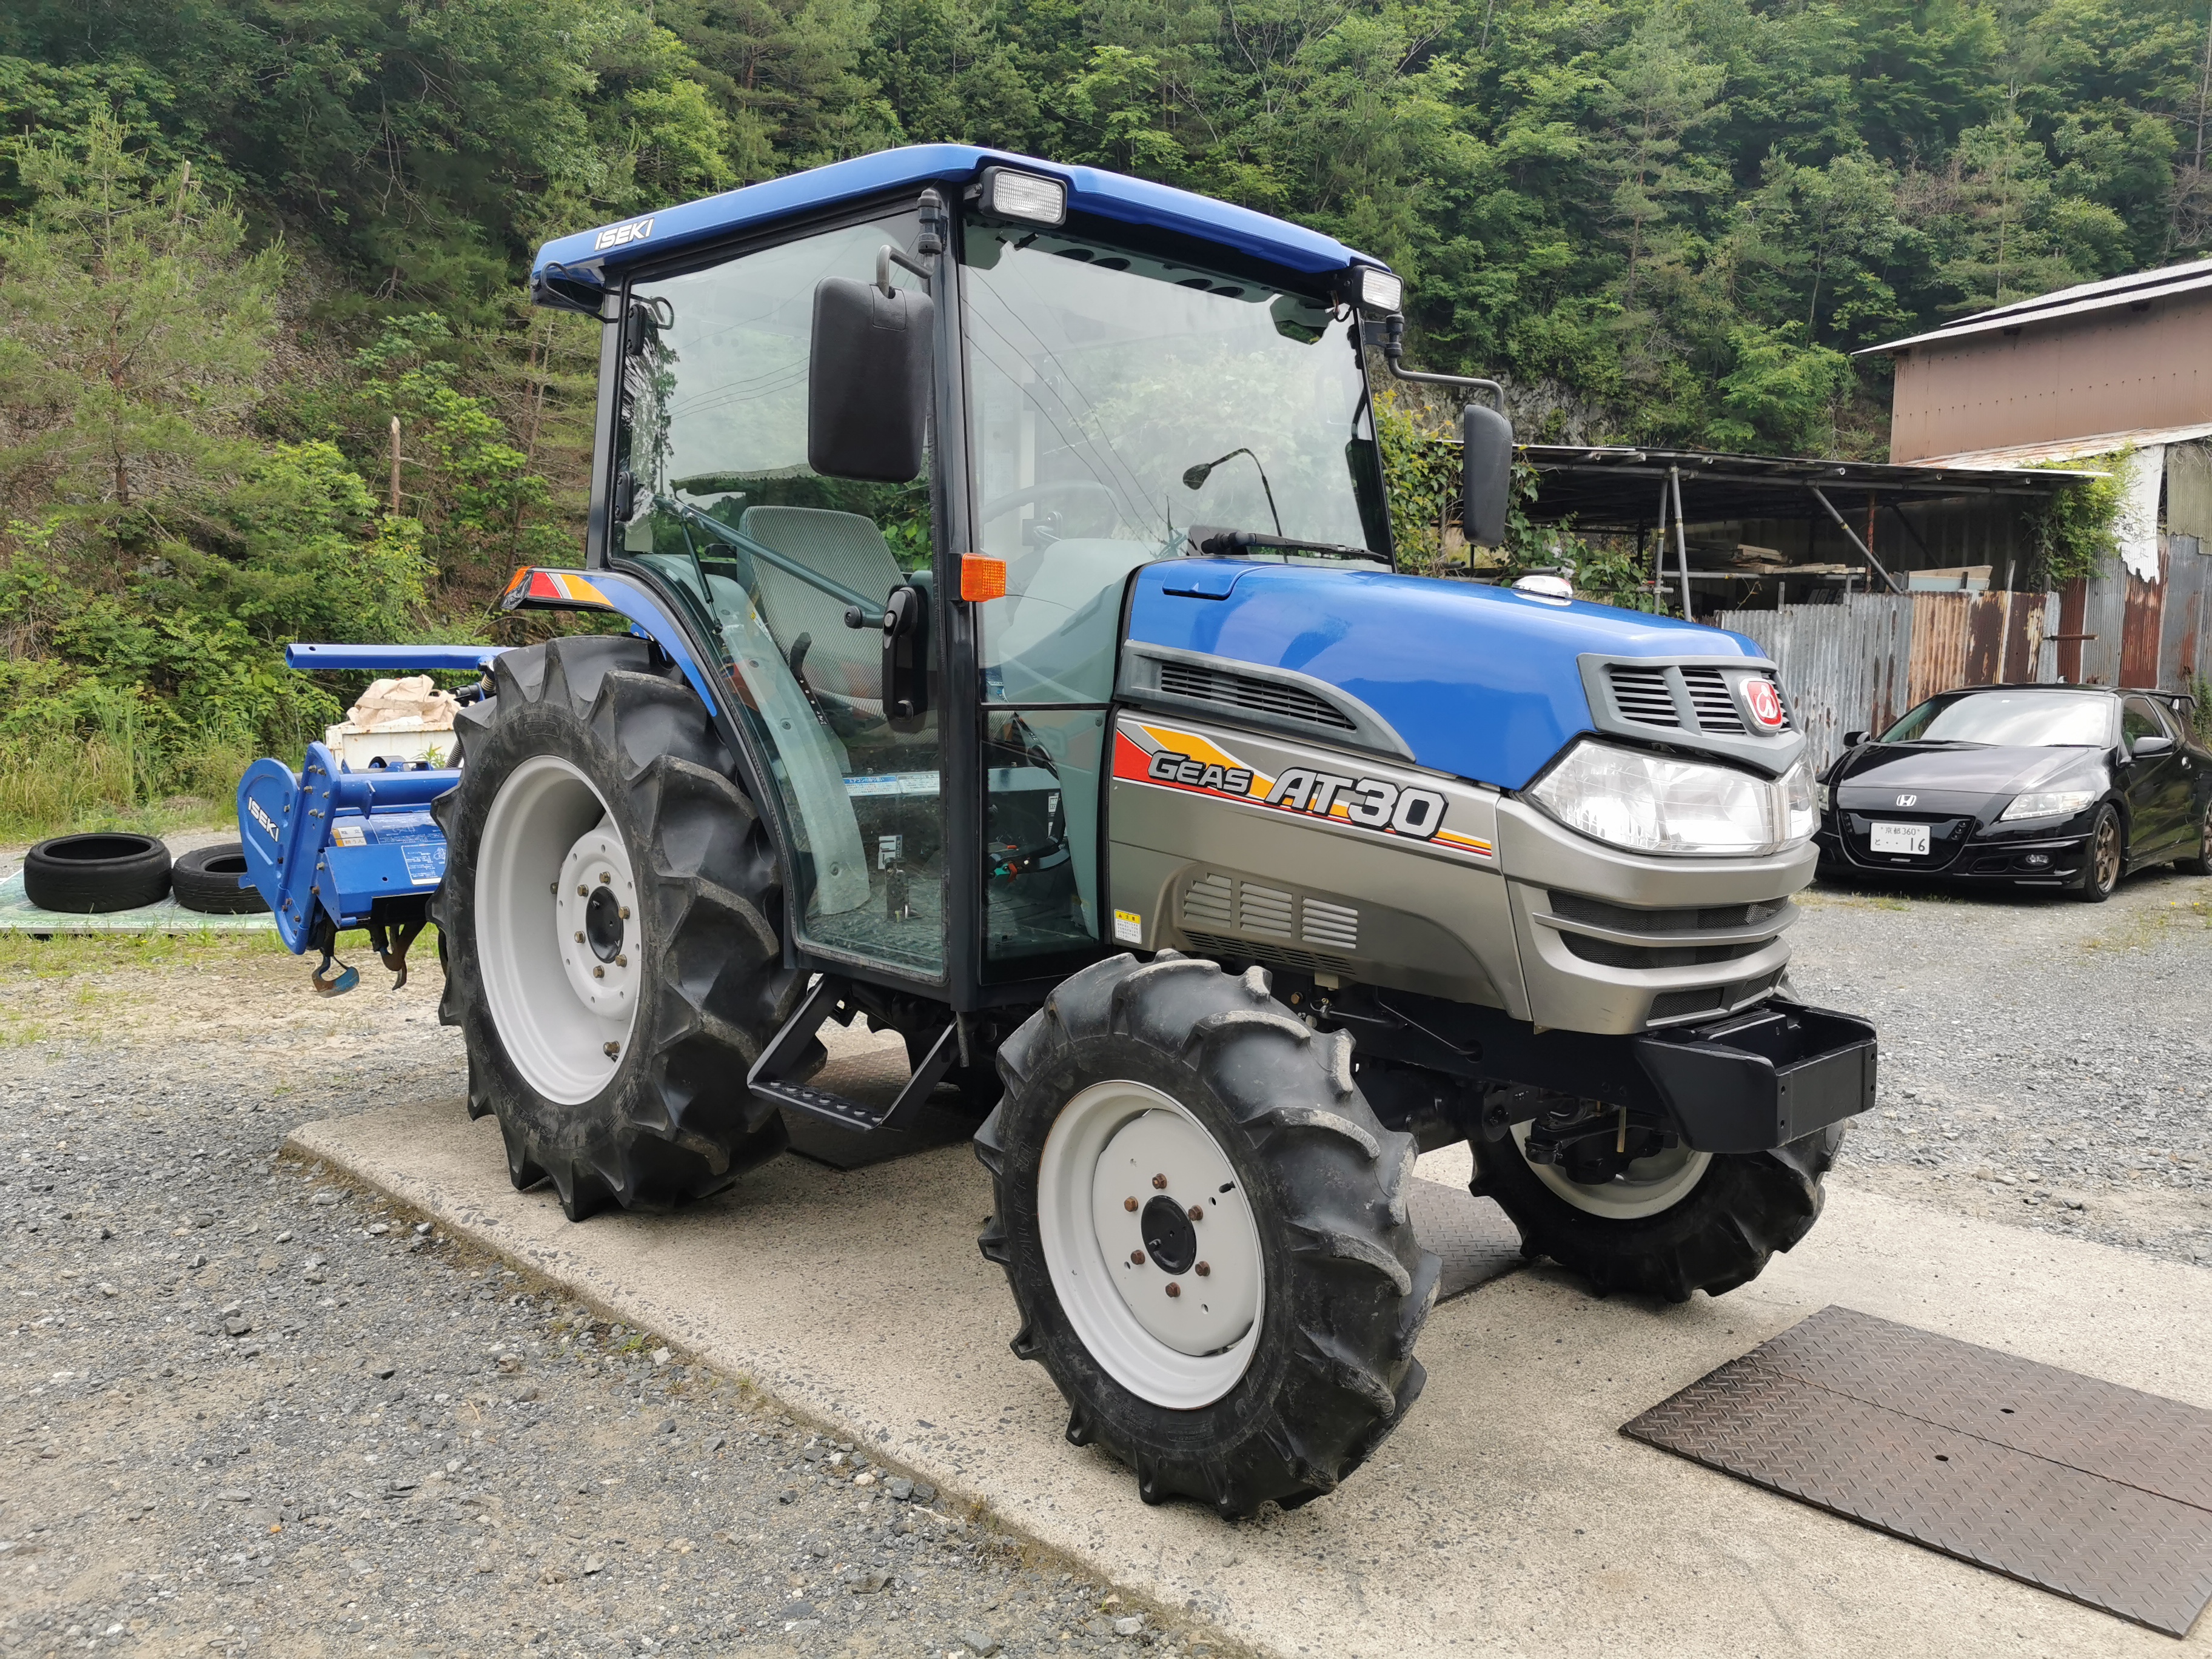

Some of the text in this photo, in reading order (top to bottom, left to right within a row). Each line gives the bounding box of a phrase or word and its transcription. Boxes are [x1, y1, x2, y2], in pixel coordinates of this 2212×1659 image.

[594, 217, 655, 251] ISEKI
[1148, 750, 1449, 840] GEAS AT30
[247, 796, 279, 842] ISEKI
